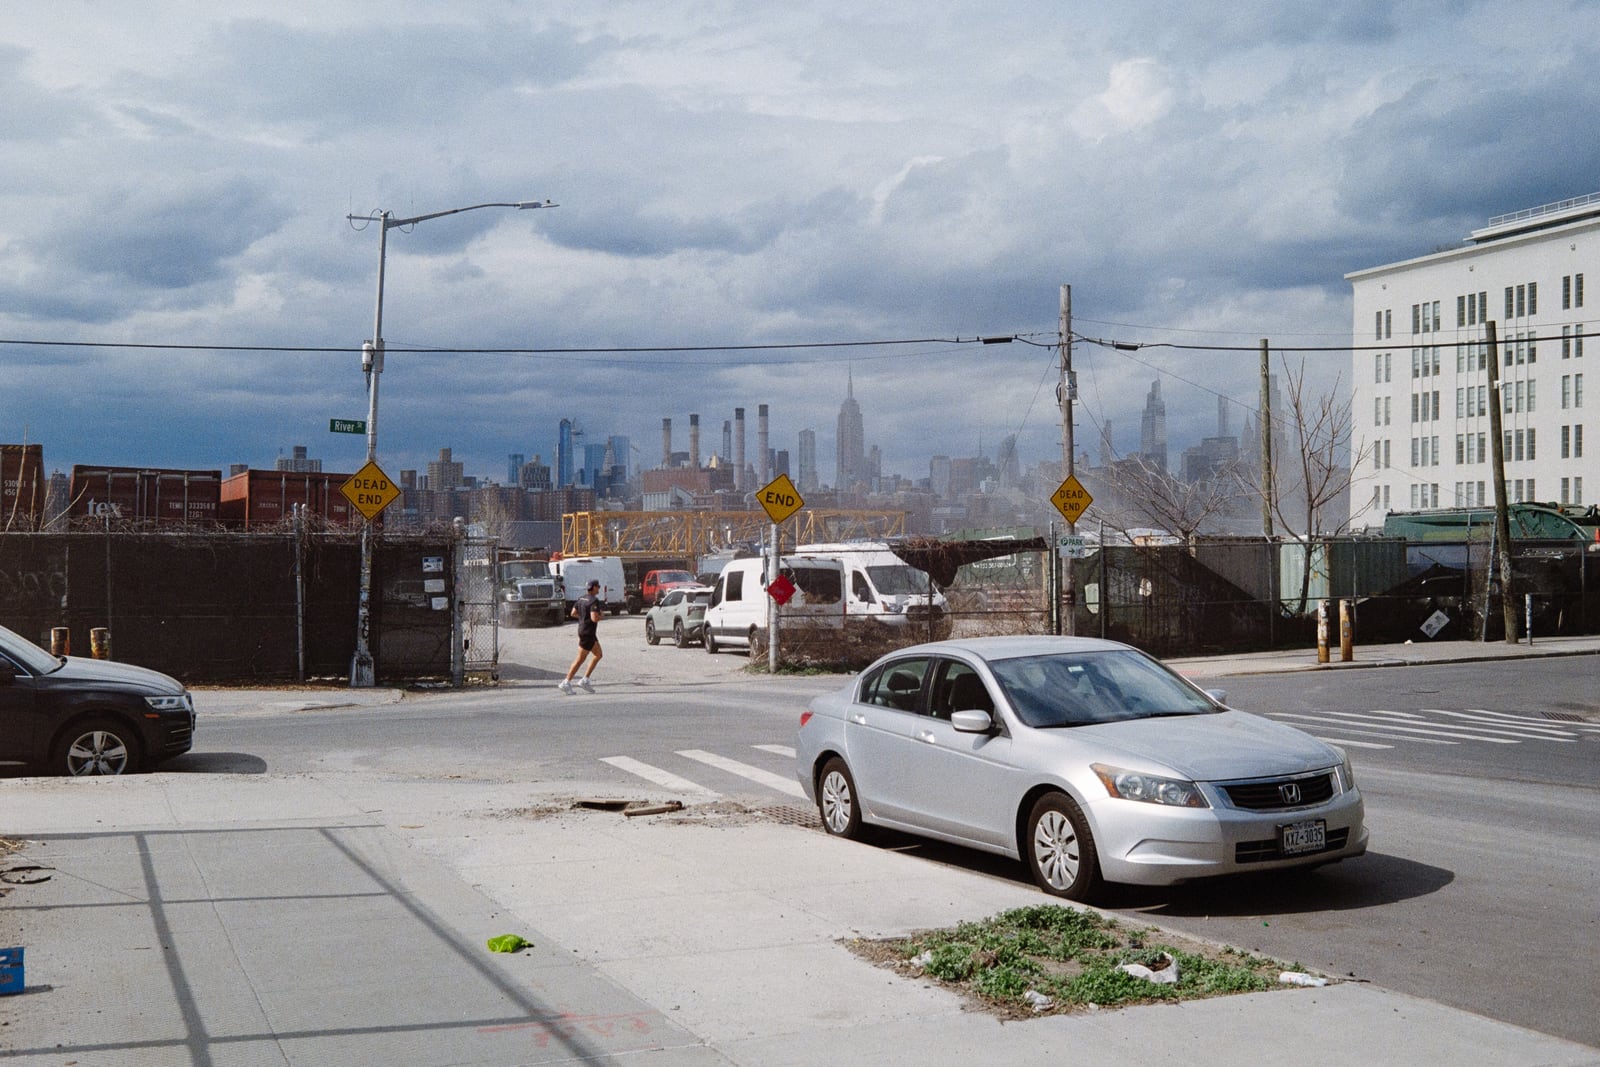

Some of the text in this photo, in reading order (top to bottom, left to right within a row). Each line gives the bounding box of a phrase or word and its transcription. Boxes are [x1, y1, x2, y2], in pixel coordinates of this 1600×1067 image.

[334, 420, 355, 432] River
[354, 479, 388, 490] DEAD
[358, 494, 382, 505] END
[765, 491, 795, 507] END
[1060, 489, 1083, 499] DEAD
[1063, 502, 1080, 511] END
[1069, 538, 1083, 546] PARK
